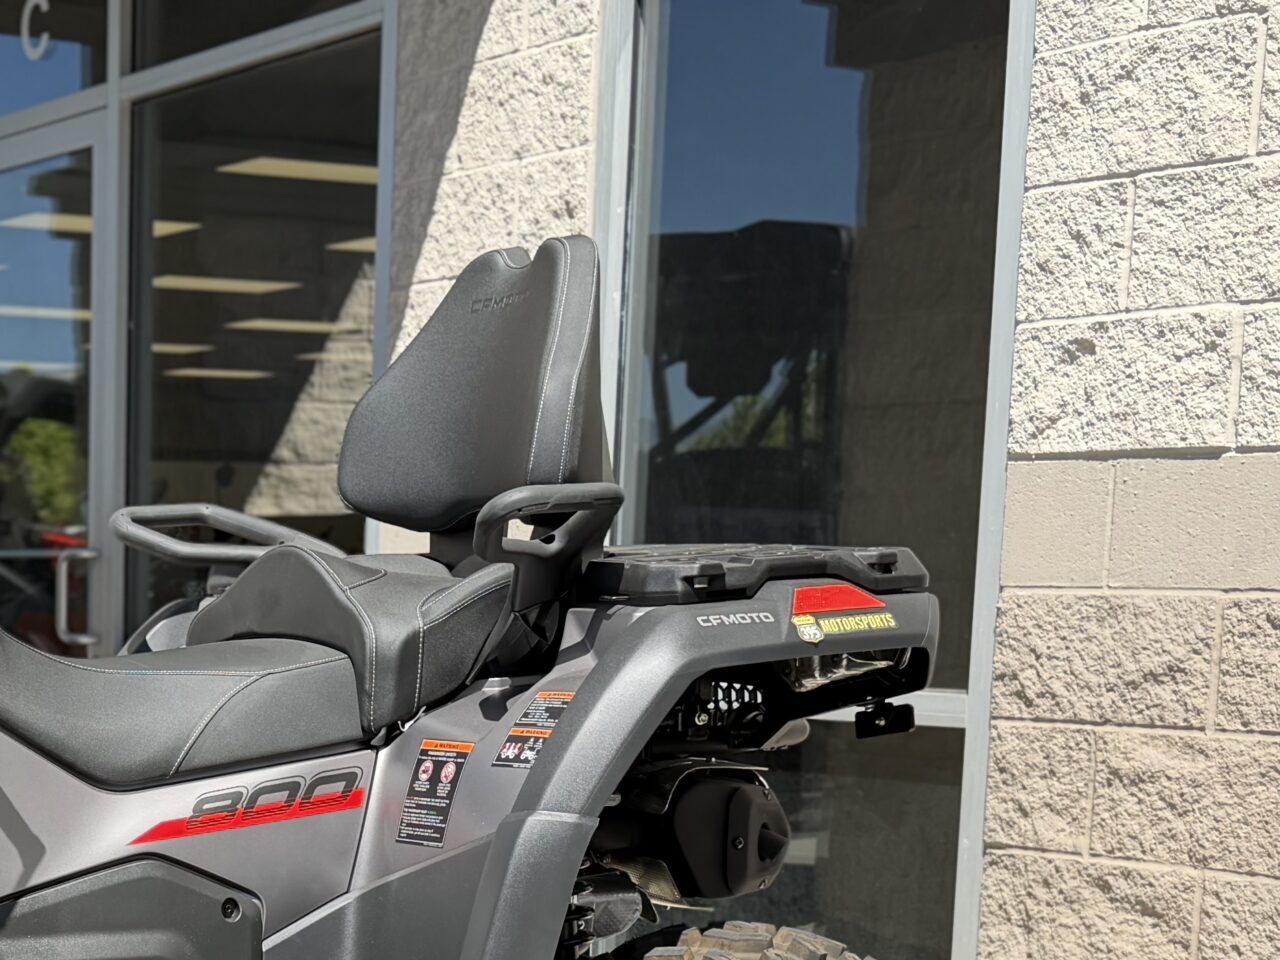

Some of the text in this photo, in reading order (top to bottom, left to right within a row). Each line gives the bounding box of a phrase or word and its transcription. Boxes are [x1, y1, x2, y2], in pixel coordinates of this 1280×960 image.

[696, 612, 775, 627] CFMOTO
[799, 613, 896, 640] 395 MOTORSPORTS
[186, 766, 363, 830] 800
